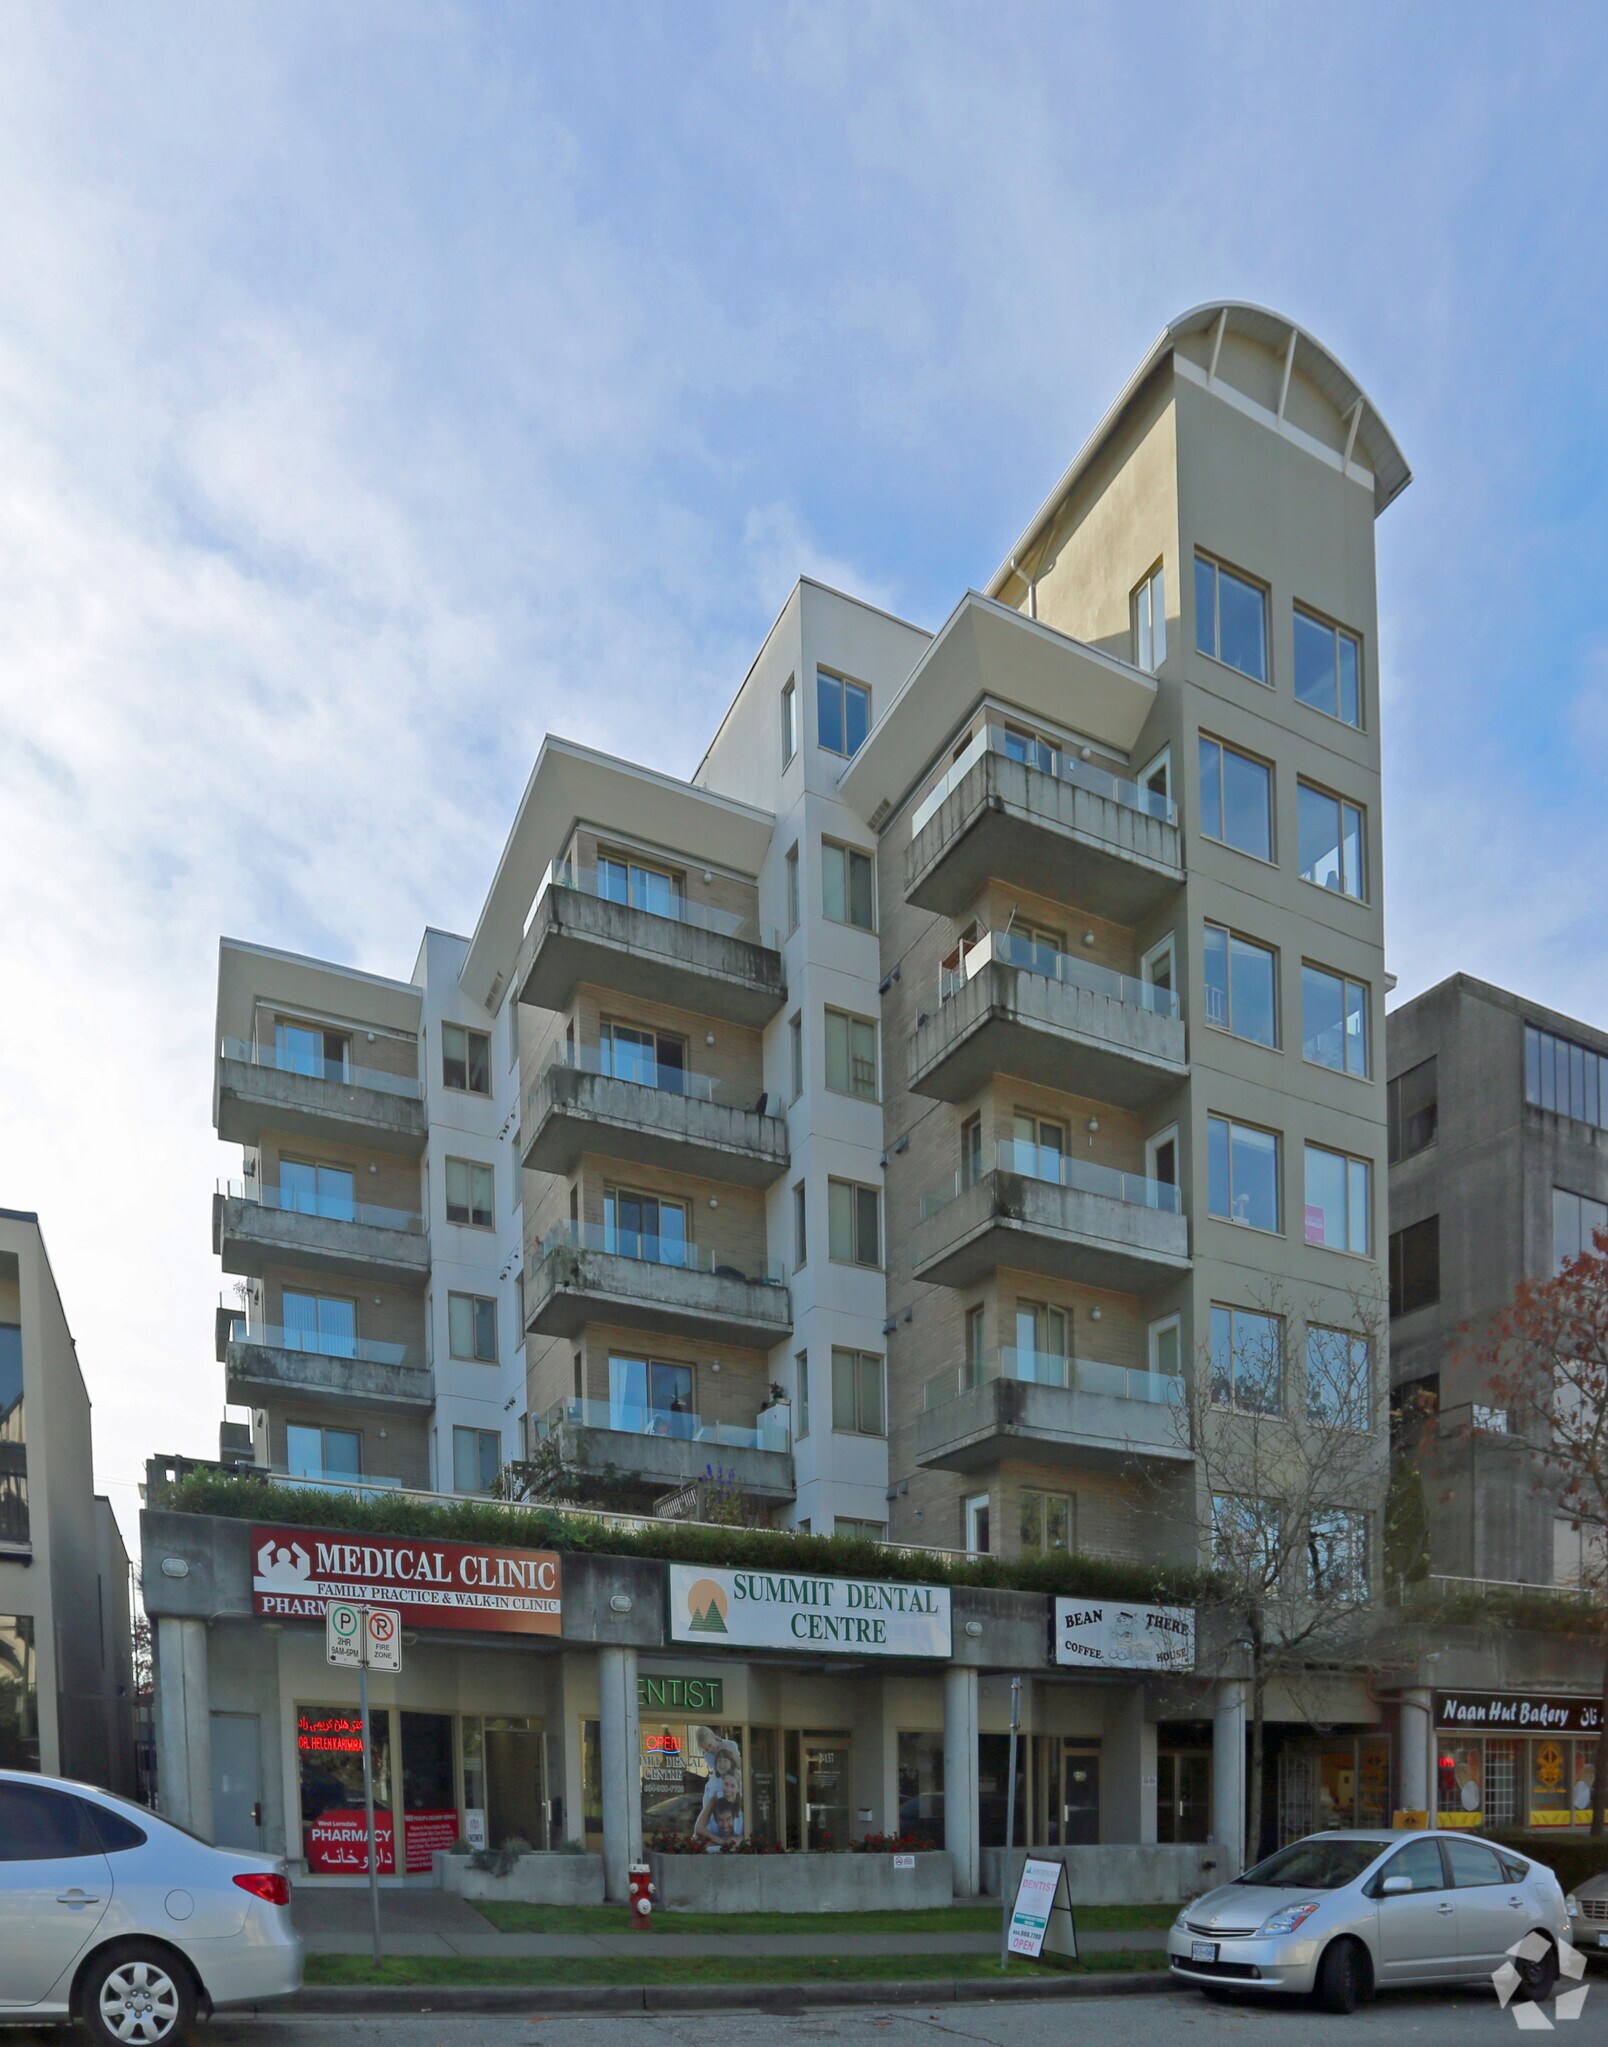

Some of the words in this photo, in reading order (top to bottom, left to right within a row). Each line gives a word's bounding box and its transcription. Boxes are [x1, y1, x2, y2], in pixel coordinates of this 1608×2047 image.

[315, 1543, 452, 1582] MEDICAL
[459, 1555, 556, 1591] CLINIC
[317, 1583, 368, 1598] FAMILY
[371, 1588, 440, 1604] PRACTICE
[442, 1595, 452, 1604] &
[455, 1596, 509, 1609] WALK-IN
[513, 1598, 557, 1612] CLINIC
[733, 1573, 834, 1606] SUMMIT
[846, 1583, 939, 1614] DENTAL
[1065, 1609, 1103, 1628] BEAN
[1146, 1613, 1190, 1636] THERE
[790, 1612, 887, 1644] CENTRE
[337, 1637, 351, 1646] 2HR
[375, 1643, 390, 1651] FIRE
[1065, 1640, 1102, 1659] COFFEE
[374, 1651, 392, 1659] ZONE
[1156, 1647, 1187, 1662] HOUSE
[637, 1679, 719, 1708] ENTIST
[1443, 1700, 1486, 1720] Naan
[1488, 1701, 1517, 1721] Hut
[1519, 1702, 1569, 1726] Bakery
[311, 1735, 333, 1751] HELEN
[646, 1735, 682, 1750] OPEN
[644, 1768, 683, 1780] CENTRE
[1022, 1879, 1057, 1892] DENTIST
[1013, 1938, 1035, 1951] OPEN
